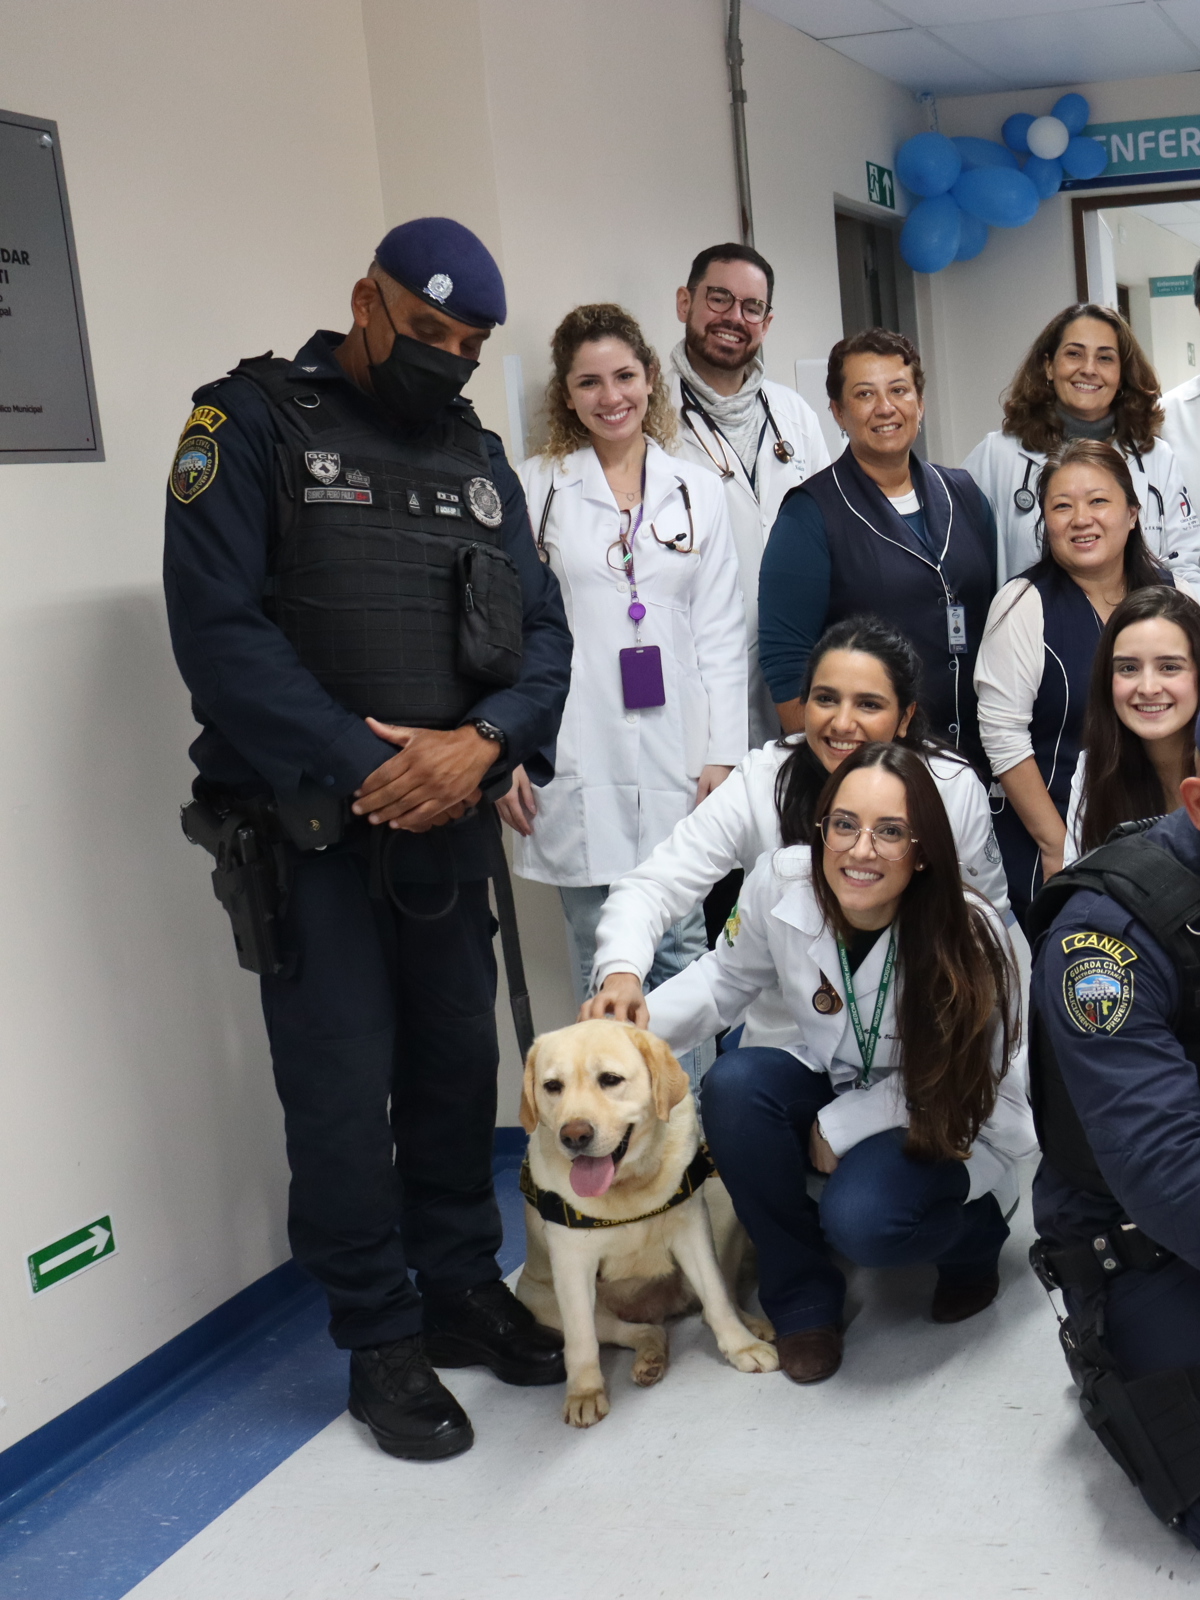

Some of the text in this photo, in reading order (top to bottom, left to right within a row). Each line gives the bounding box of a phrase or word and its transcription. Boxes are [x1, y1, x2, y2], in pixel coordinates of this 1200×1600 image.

[12, 403, 43, 415] Municipal
[192, 409, 216, 424] NIL
[308, 453, 338, 461] GCM
[1073, 934, 1126, 960] CANIL
[841, 948, 853, 993] UNINOVE MEDICINA
[882, 960, 894, 984] MEDICINA
[1069, 961, 1126, 978] GUARDA CIVIL
[1074, 968, 1122, 982] METROPOLITANA
[850, 1002, 862, 1024] MEDICINA
[872, 990, 886, 1028] UNINOVE MEDICINA
[1068, 986, 1097, 1033] POLICIAMENTO
[1105, 985, 1130, 1032] PREVENTIVO
[593, 1202, 671, 1227] COMUNARIA
